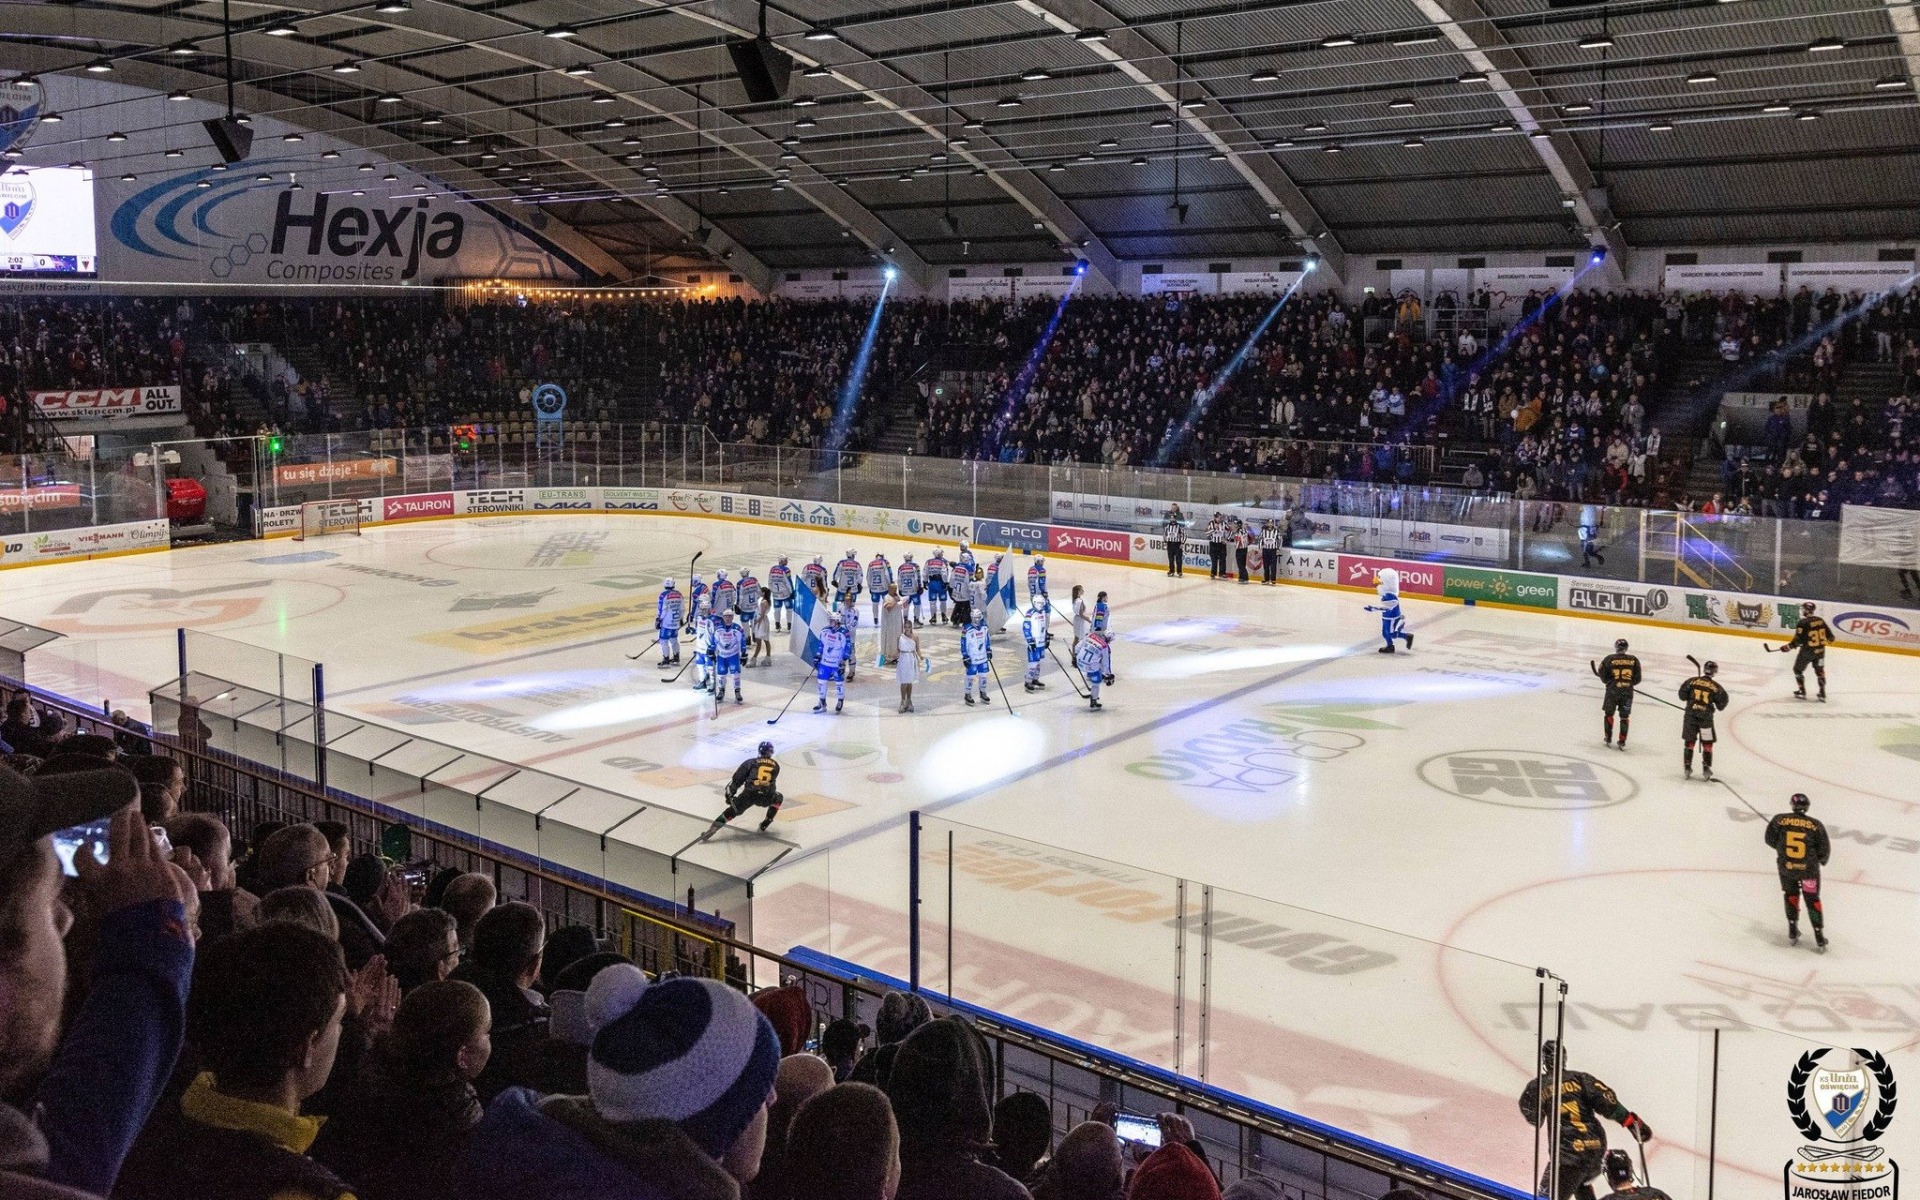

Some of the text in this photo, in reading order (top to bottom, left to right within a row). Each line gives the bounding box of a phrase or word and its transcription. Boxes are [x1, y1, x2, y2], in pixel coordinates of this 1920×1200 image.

[270, 191, 464, 280] Hexja
[267, 260, 394, 285] Composites
[33, 389, 141, 409] CCM
[146, 389, 170, 400] ALL
[146, 399, 176, 411] OUT.
[283, 469, 296, 480] tu
[299, 467, 315, 482] się
[319, 464, 351, 479] dzieje
[467, 490, 523, 504] TECH
[541, 491, 585, 499] EU-TRANS
[318, 501, 373, 517] TECH
[404, 499, 451, 513] TAURON
[467, 503, 523, 514] STEROWNIKI
[263, 518, 294, 528] ROLETY
[319, 514, 373, 528] STEROWNIKI
[780, 511, 805, 523] OTBS
[809, 514, 836, 526] OTBS
[922, 522, 969, 538] PWiK
[1001, 526, 1042, 539] arco
[1073, 535, 1122, 553] TAURON
[1280, 568, 1322, 579] SUSHI
[1371, 567, 1433, 587] TRON
[1446, 576, 1555, 598] power green
[1571, 580, 1594, 588] Serwis
[1740, 609, 1759, 619] WP
[1850, 619, 1892, 636] PKS
[1083, 648, 1095, 663] 77
[757, 765, 774, 783] 6
[1786, 830, 1807, 859] 5
